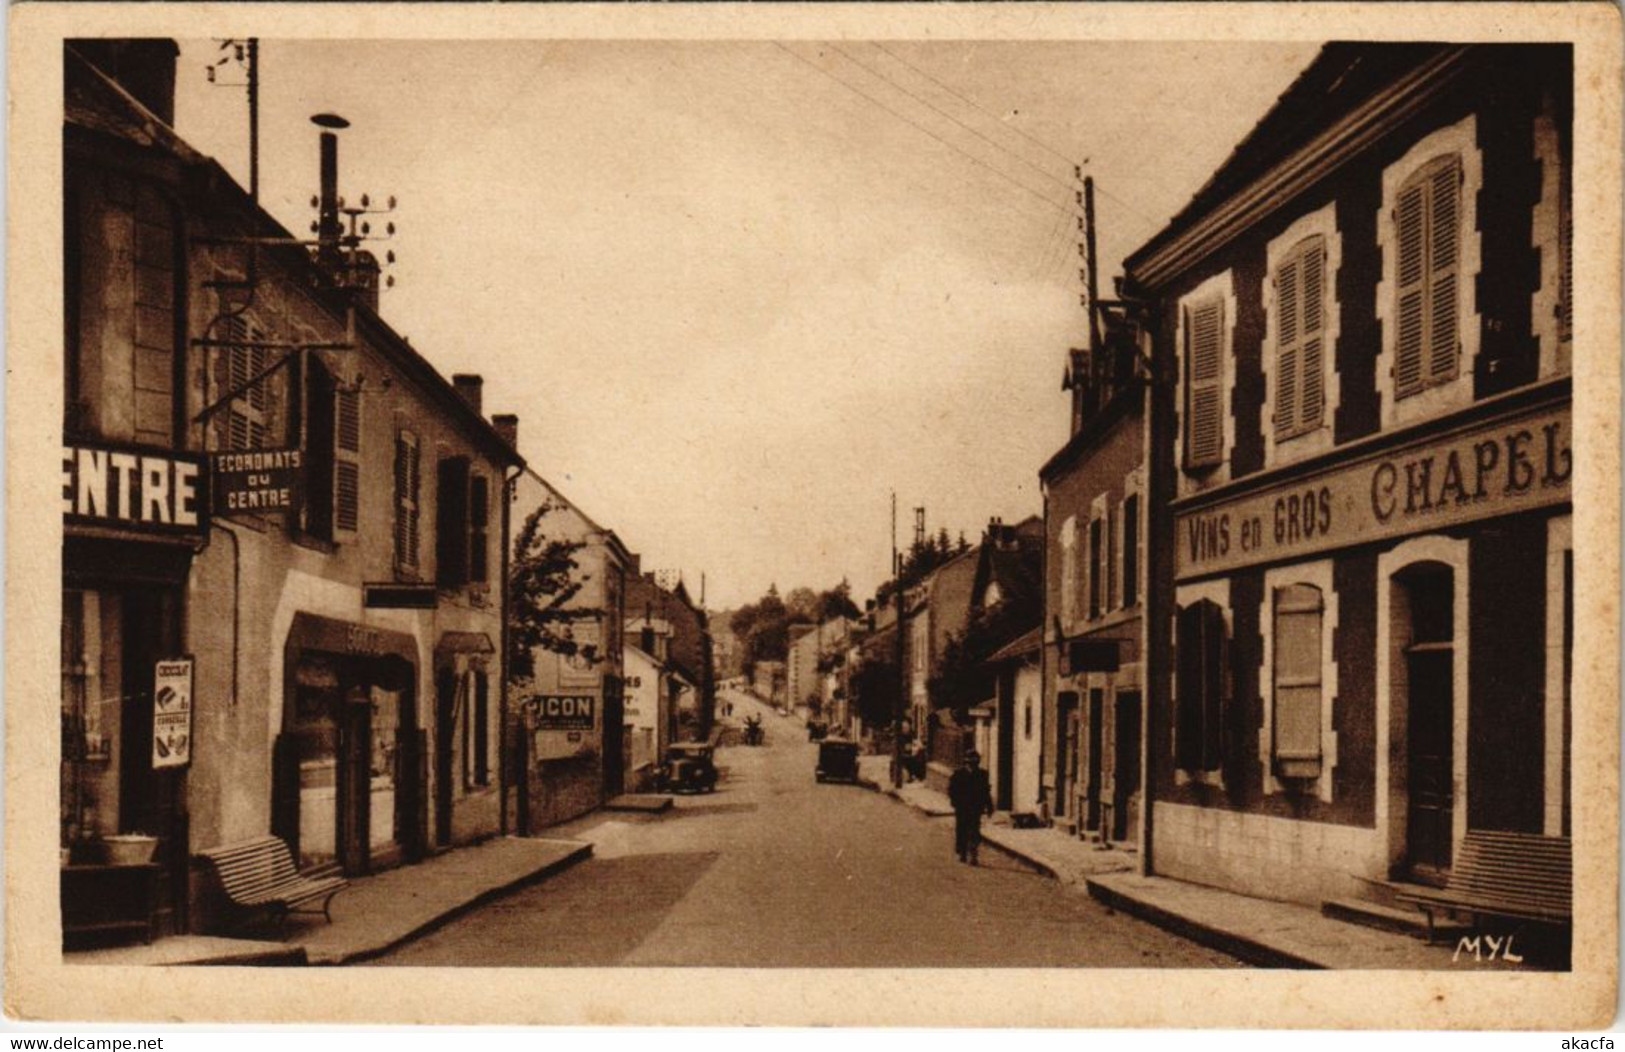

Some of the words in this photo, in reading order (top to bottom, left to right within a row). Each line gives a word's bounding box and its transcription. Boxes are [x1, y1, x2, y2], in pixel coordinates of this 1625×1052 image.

[62, 446, 198, 525] ENTRE
[218, 451, 300, 472] ECONOMATS
[228, 488, 290, 509] CENTRE
[1189, 513, 1230, 562] VINS
[1241, 517, 1262, 551] en
[1274, 486, 1331, 544] GROS
[1370, 421, 1572, 525] CHAPEL
